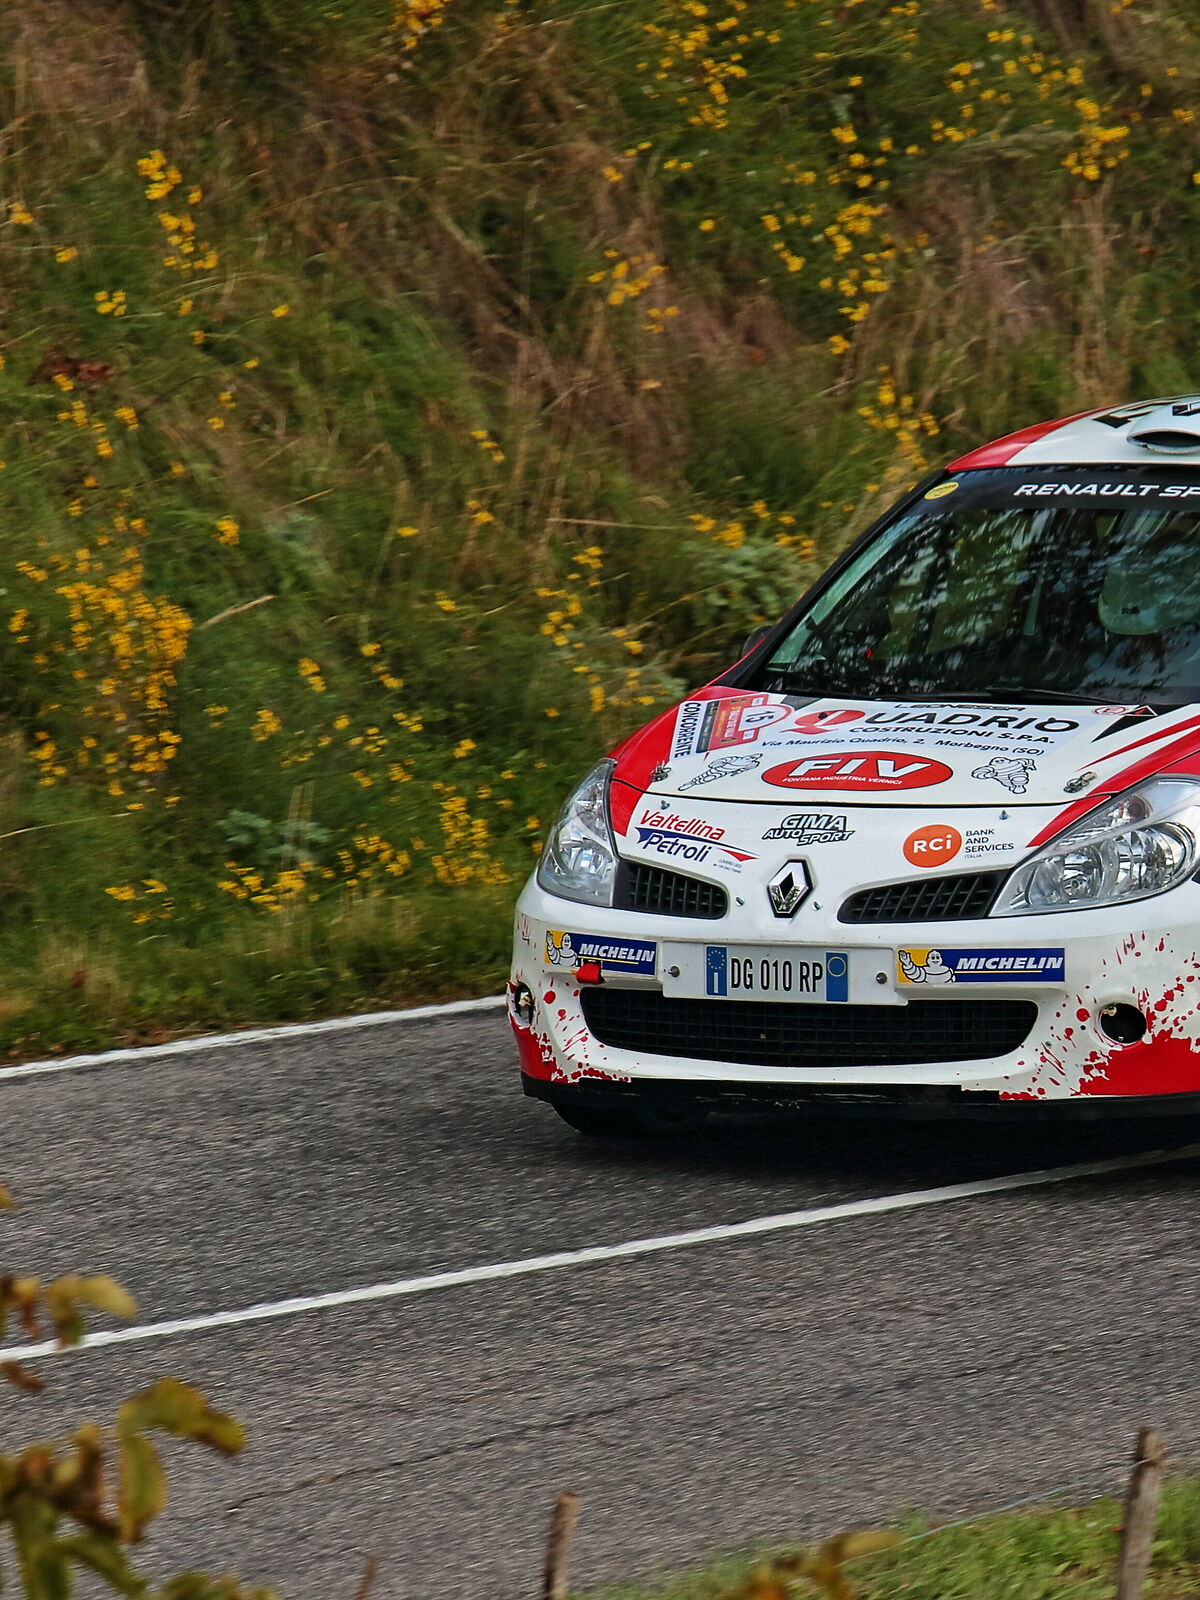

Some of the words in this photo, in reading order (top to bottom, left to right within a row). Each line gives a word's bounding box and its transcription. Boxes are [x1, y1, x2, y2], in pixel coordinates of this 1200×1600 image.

[1014, 483, 1161, 497] RENAULT
[894, 703, 1026, 711] LEONESSA
[745, 711, 775, 723] 15
[674, 702, 702, 758] CONCORRENTE
[849, 726, 999, 738] COSTRUZIONI
[998, 732, 1055, 744] S.P.A.
[762, 739, 781, 747] Via
[785, 738, 847, 746] Maurizio
[936, 739, 1009, 752] Morbegno
[1012, 746, 1044, 757] (SO)
[788, 758, 933, 778] FIV
[641, 810, 725, 840] Valtellina
[781, 814, 848, 831] GIMA
[762, 829, 801, 840] AUTO
[797, 829, 856, 847] SPORT
[965, 828, 995, 837] BANK
[965, 836, 989, 845] AND
[643, 833, 711, 862] Petroli
[913, 834, 952, 853] RCi
[964, 843, 1014, 853] SERVICES
[580, 942, 655, 963] MICHELIN
[956, 957, 1063, 970] MICHELIN
[730, 957, 753, 990] DG
[760, 959, 792, 992] 010
[800, 961, 823, 993] RP
